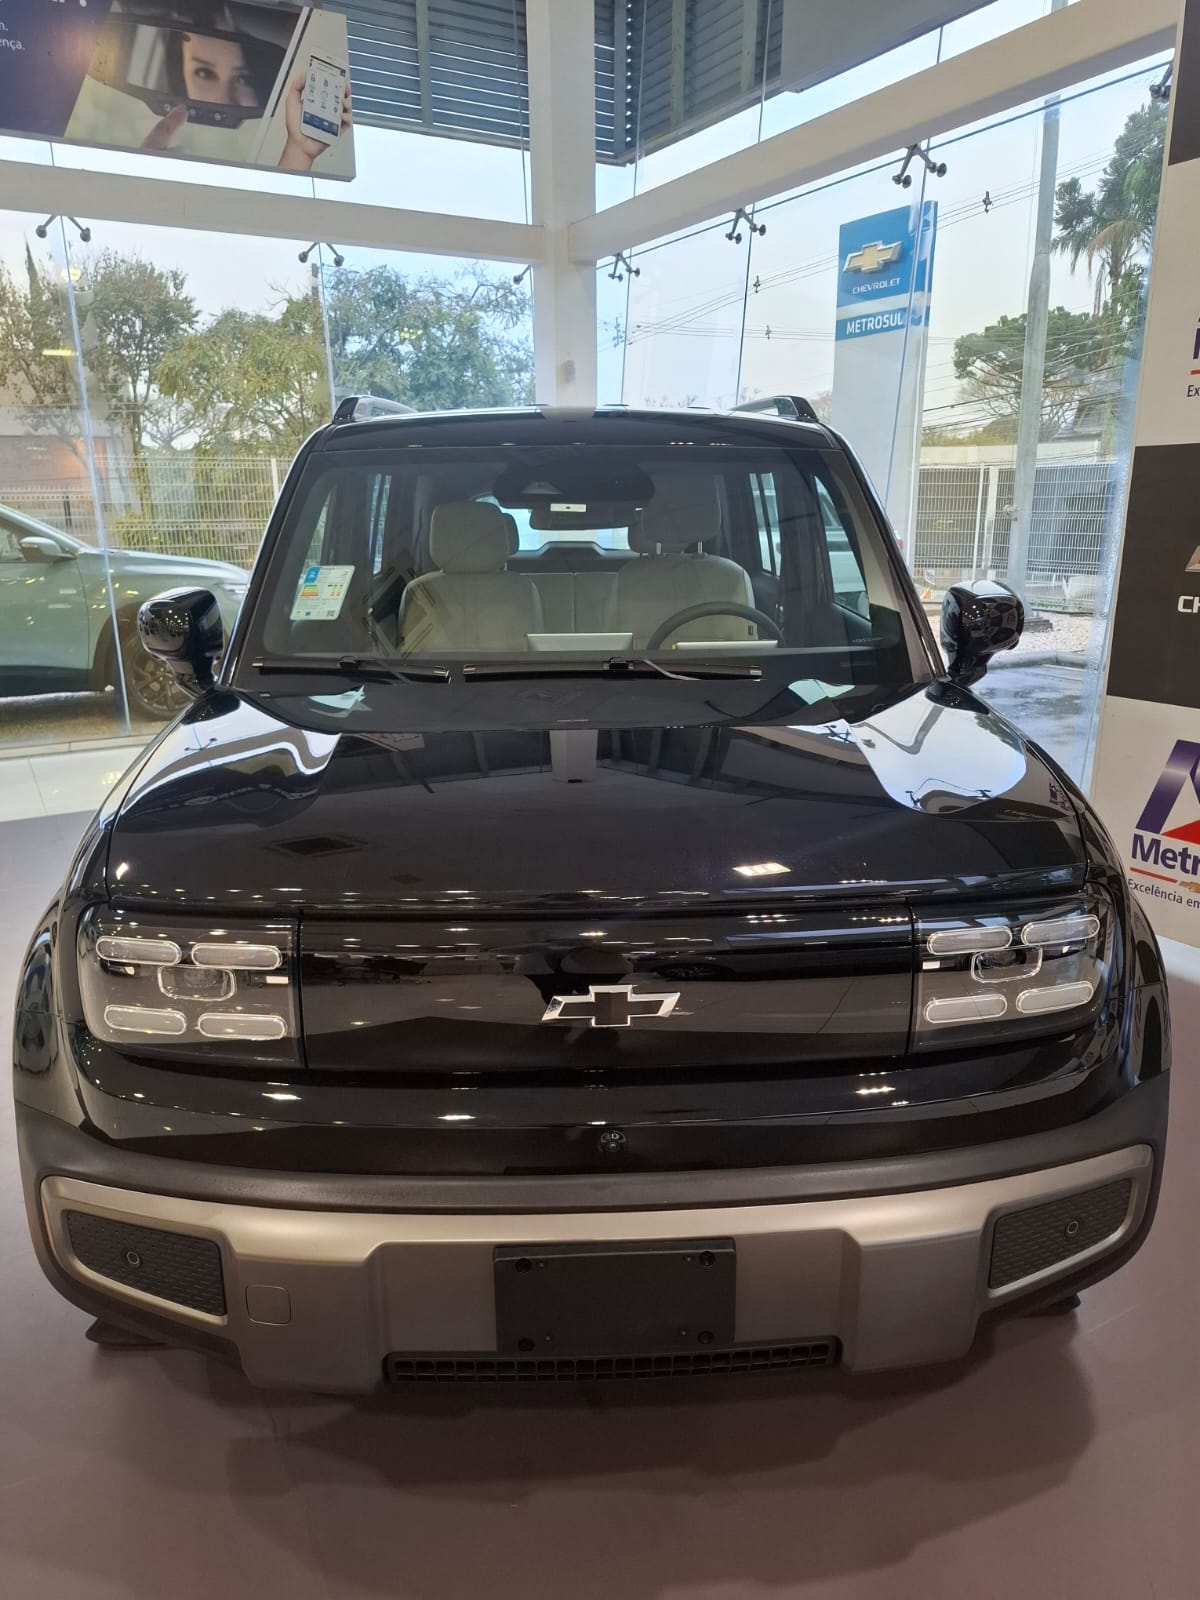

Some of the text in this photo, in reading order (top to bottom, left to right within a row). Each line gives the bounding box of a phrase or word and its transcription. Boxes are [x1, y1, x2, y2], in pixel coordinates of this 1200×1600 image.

[852, 278, 901, 294] CHEVROLET
[846, 312, 903, 334] METROSUL
[1128, 879, 1183, 904] Excelência
